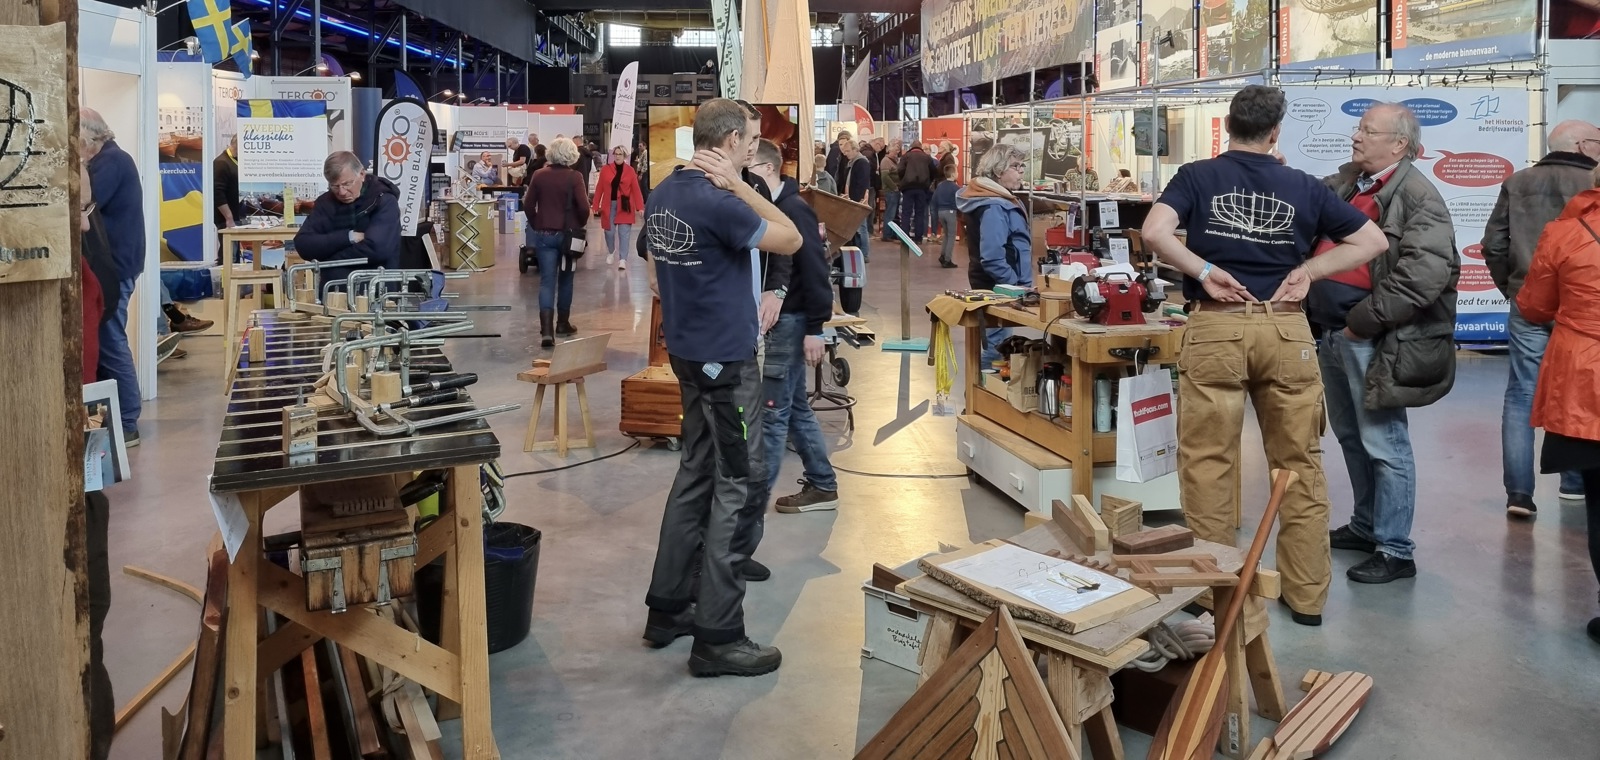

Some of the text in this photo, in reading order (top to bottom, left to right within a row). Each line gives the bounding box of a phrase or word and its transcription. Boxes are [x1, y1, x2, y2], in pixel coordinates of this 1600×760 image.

[1425, 52, 1432, 61] de
[1433, 49, 1459, 60] moderne
[1460, 44, 1499, 57] binnenvaart.
[243, 124, 294, 133] ZWEEDSE
[243, 129, 294, 141] klassieker
[243, 141, 272, 150] CLUB
[411, 119, 428, 171] BLASTER
[401, 175, 419, 232] ROTATING
[1204, 229, 1241, 240] Ambachtelijk
[1476, 297, 1489, 306] ter
